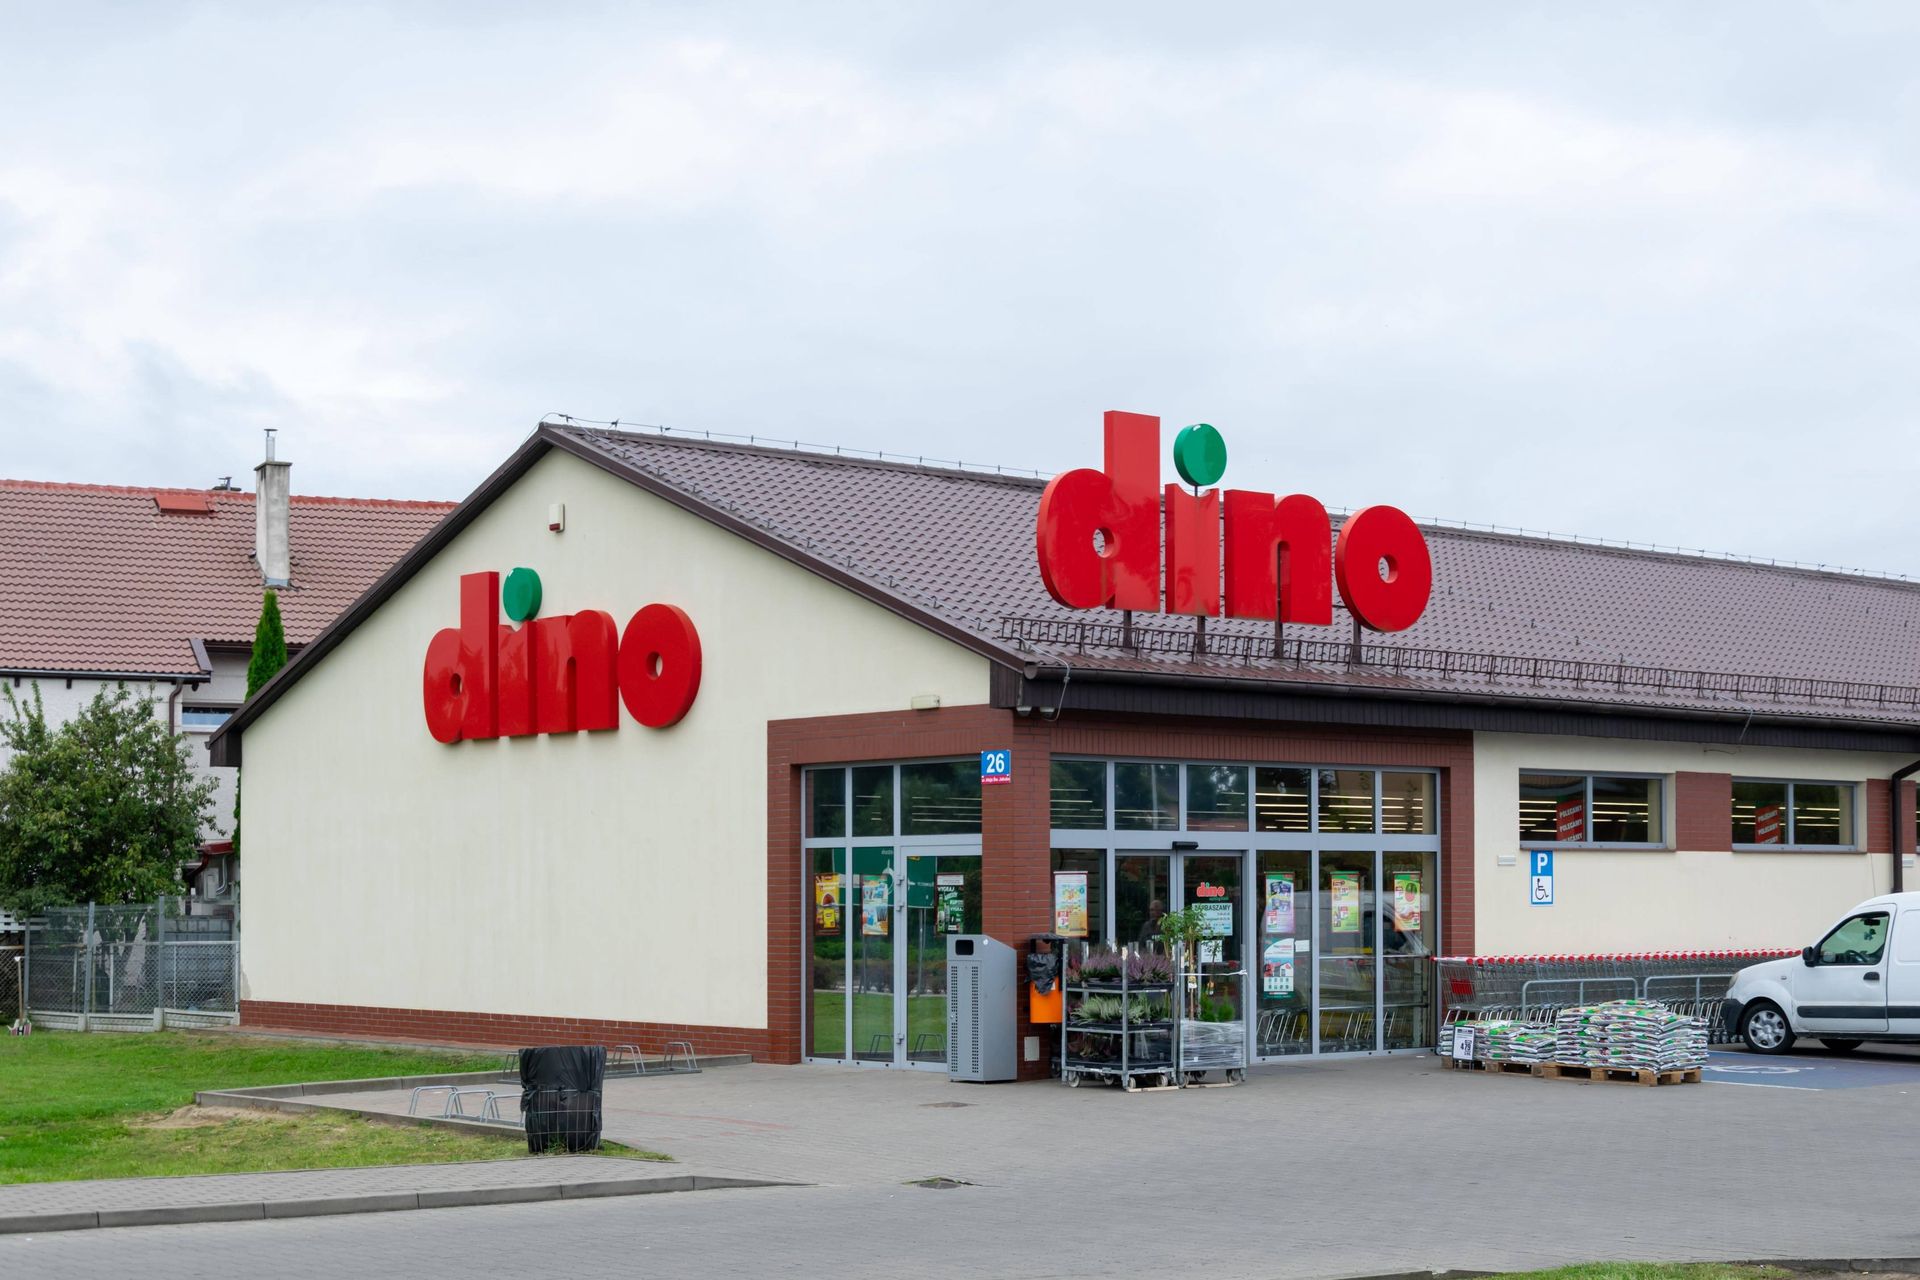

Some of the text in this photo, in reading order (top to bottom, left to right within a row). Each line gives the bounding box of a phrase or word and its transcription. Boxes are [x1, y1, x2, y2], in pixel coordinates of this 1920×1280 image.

[1036, 410, 1432, 632] dino
[423, 567, 702, 743] dino
[986, 753, 1005, 773] 26
[1537, 852, 1548, 874] P
[1196, 881, 1225, 898] dino
